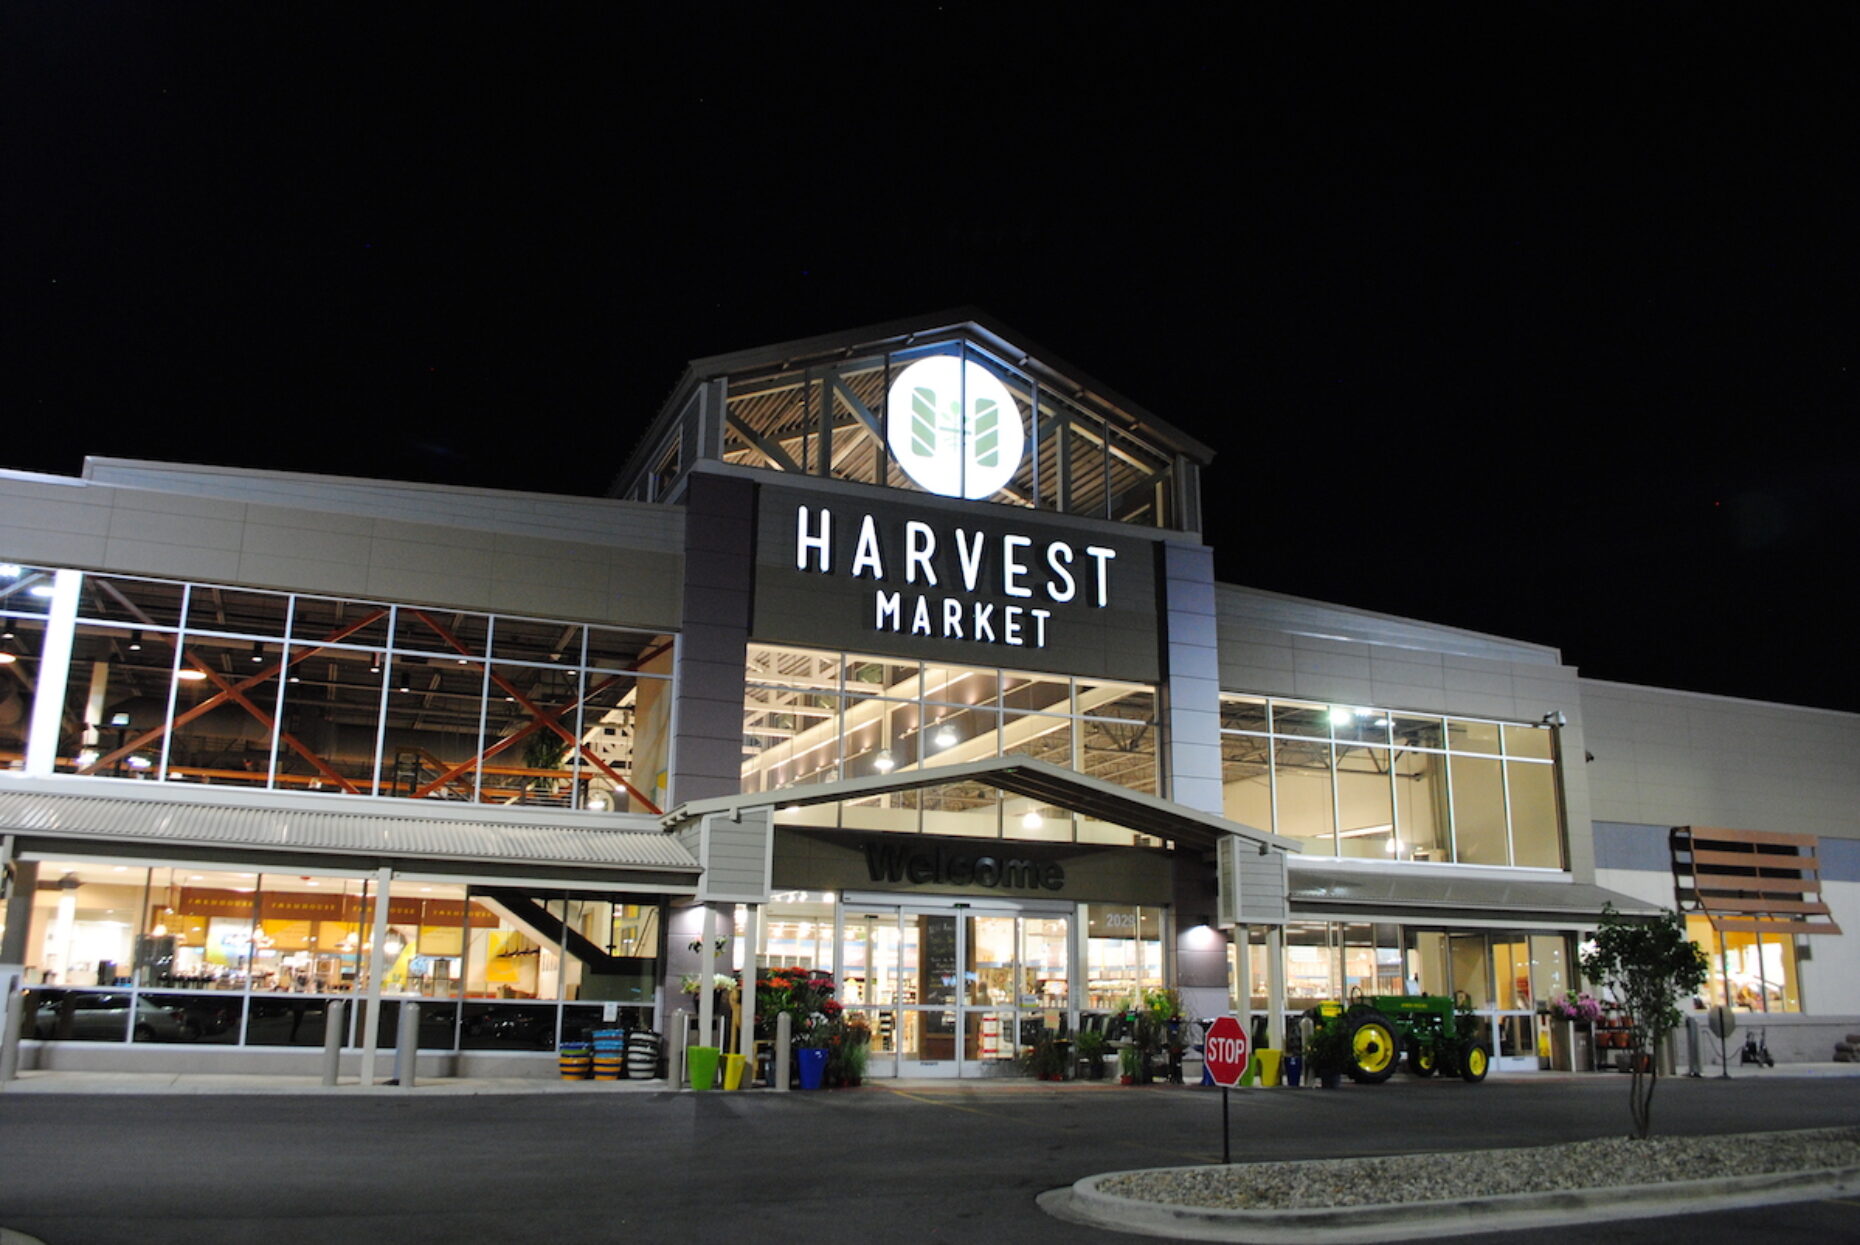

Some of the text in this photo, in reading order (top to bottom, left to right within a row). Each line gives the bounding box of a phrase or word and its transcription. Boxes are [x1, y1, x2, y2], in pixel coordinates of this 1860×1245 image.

[796, 504, 1116, 608] HARVEST
[875, 589, 1051, 648] MARKET
[864, 842, 1066, 891] Welcome
[1106, 913, 1136, 928] 2029
[1208, 1037, 1245, 1064] STOP
